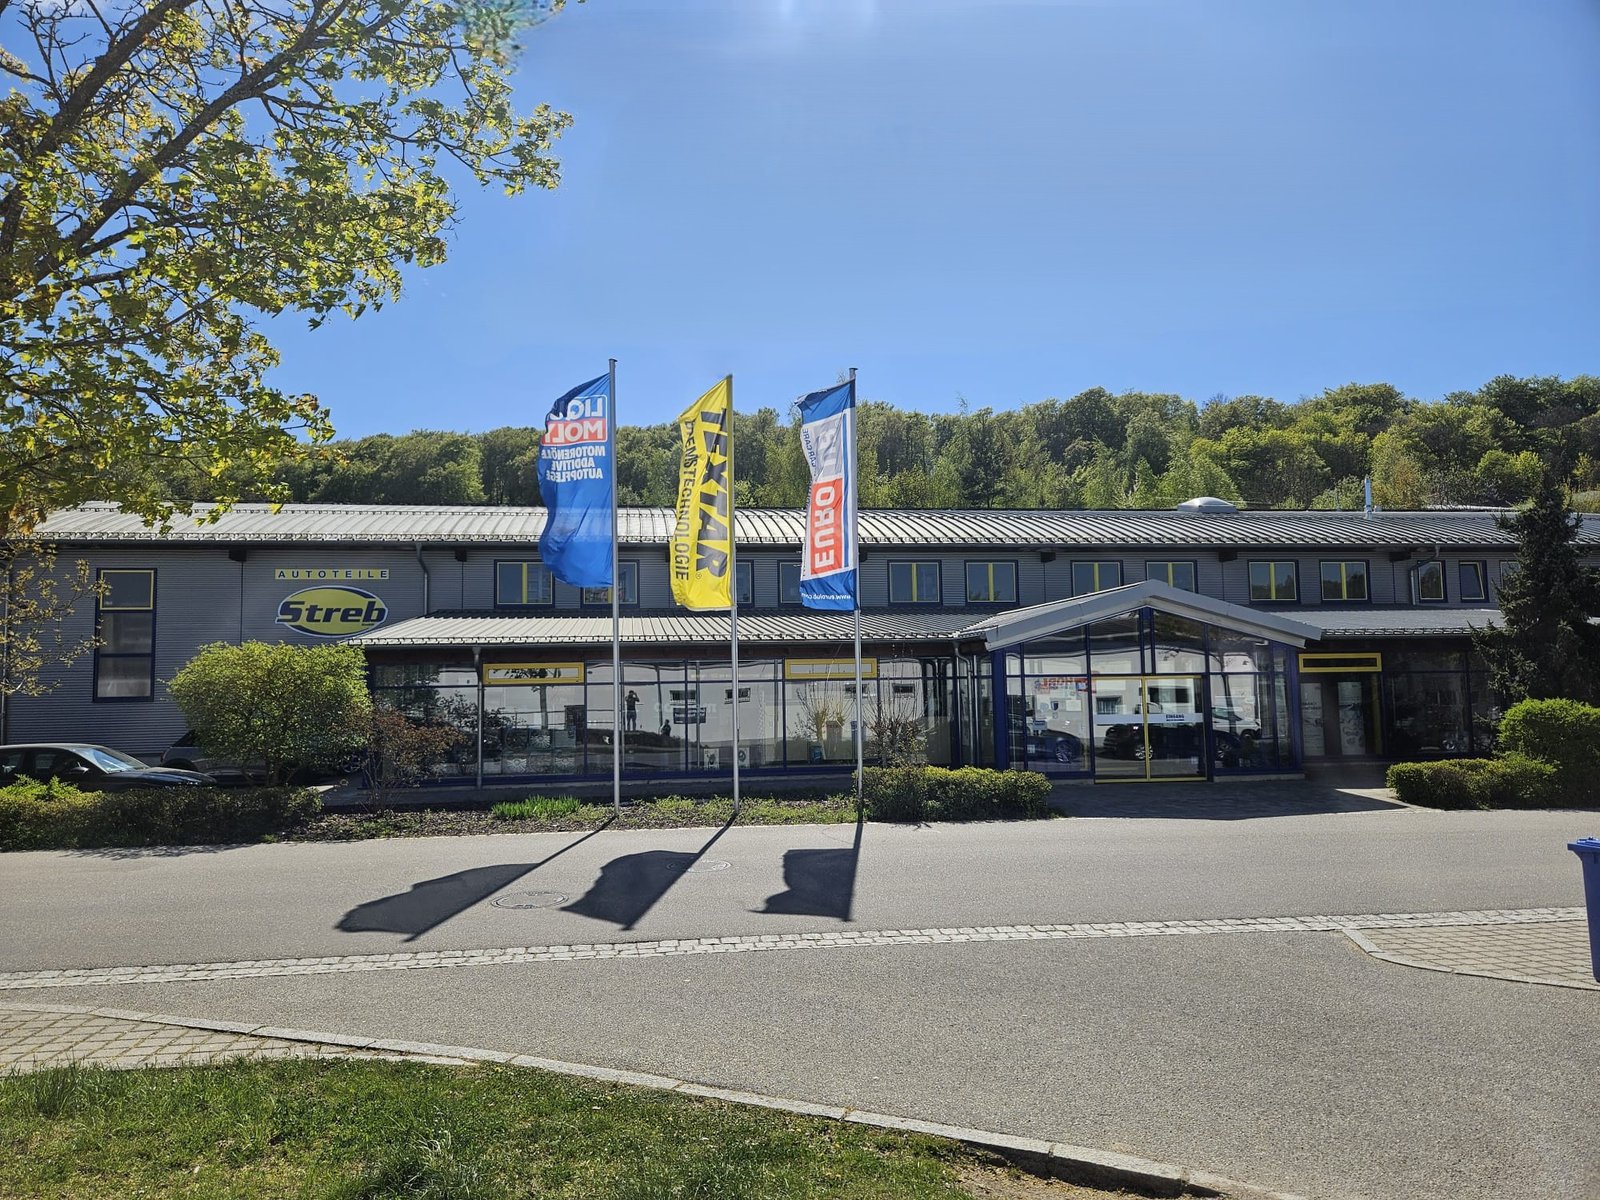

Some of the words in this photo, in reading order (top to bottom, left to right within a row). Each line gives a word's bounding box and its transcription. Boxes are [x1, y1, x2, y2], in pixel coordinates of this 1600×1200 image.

[696, 408, 728, 577] TEXTAR
[278, 570, 388, 578] AUTOTEILE
[276, 600, 387, 623] Streb
